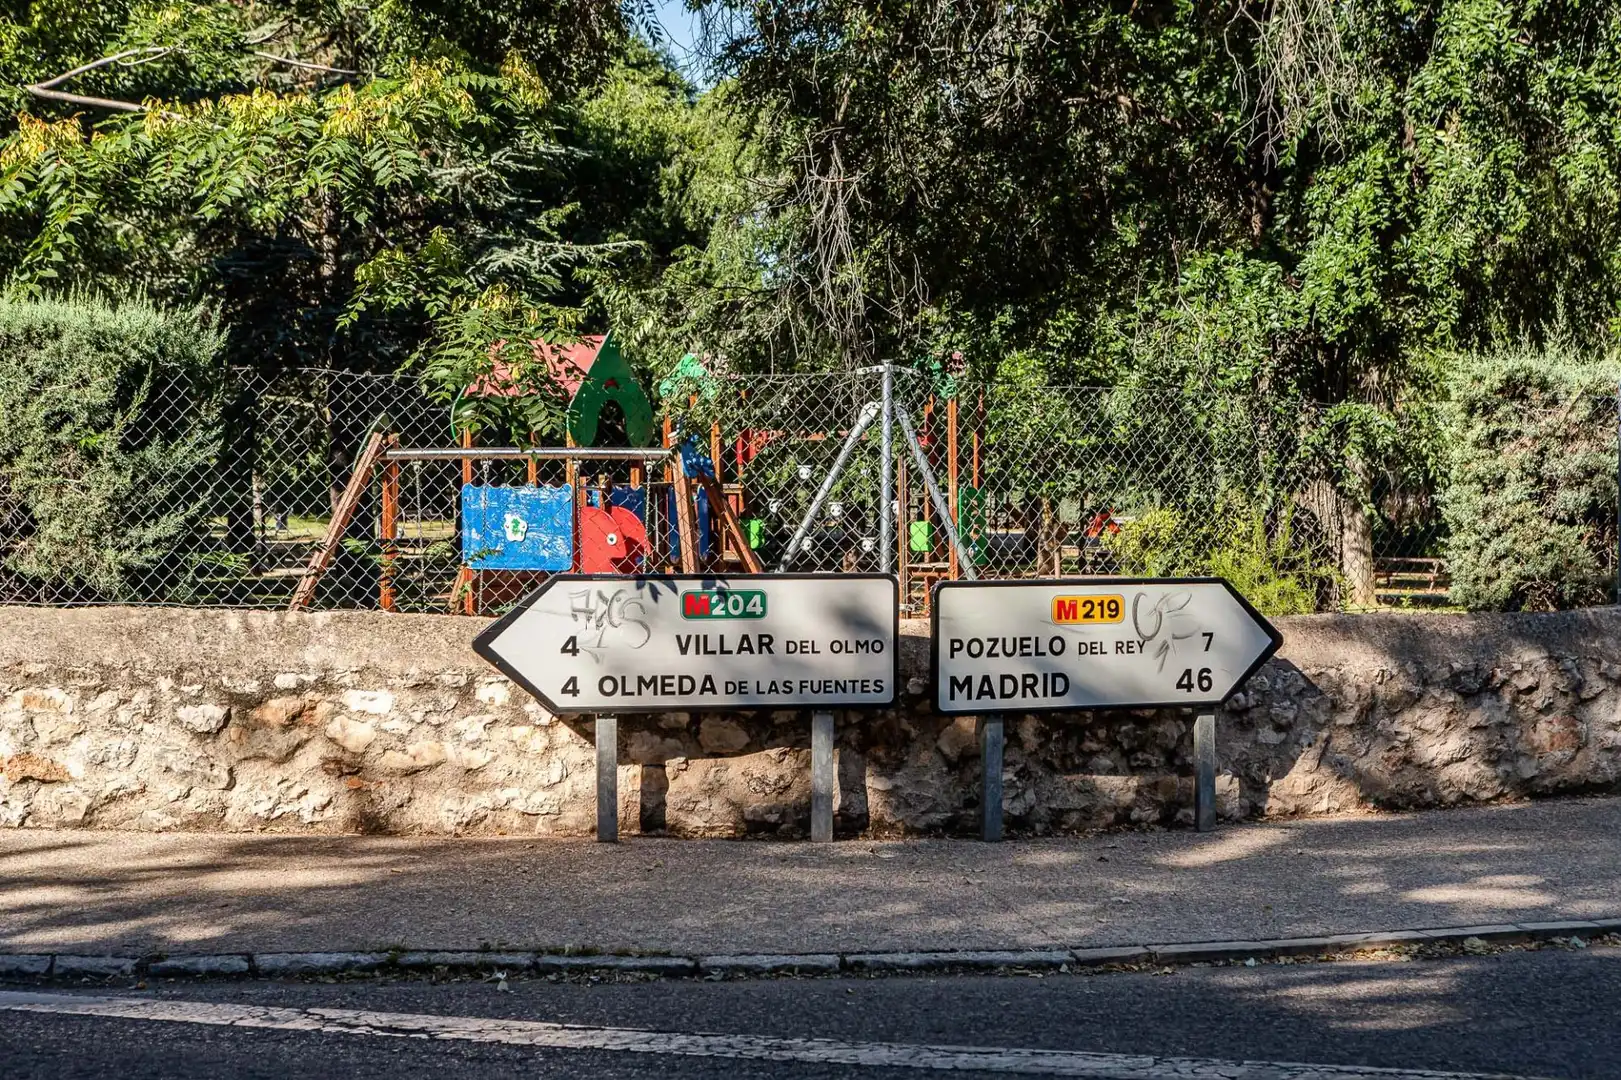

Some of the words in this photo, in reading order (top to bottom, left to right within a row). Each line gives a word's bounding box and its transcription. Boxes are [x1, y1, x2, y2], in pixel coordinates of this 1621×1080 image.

[684, 593, 764, 616] M204
[560, 635, 580, 657] 4
[675, 633, 775, 656] VILLAR
[785, 640, 821, 655] DEL
[829, 639, 885, 655] OLMO
[949, 635, 1067, 660] POZUELO
[1078, 641, 1108, 656] DEL
[1115, 640, 1147, 655] REY
[1201, 631, 1214, 652] 7
[560, 675, 580, 697] 4
[598, 674, 718, 697] OLMEDA
[724, 680, 750, 696] DE
[755, 679, 794, 695] LAS
[798, 678, 885, 695] FUENTES
[949, 671, 1071, 701] MADRID
[1175, 667, 1214, 693] 46
